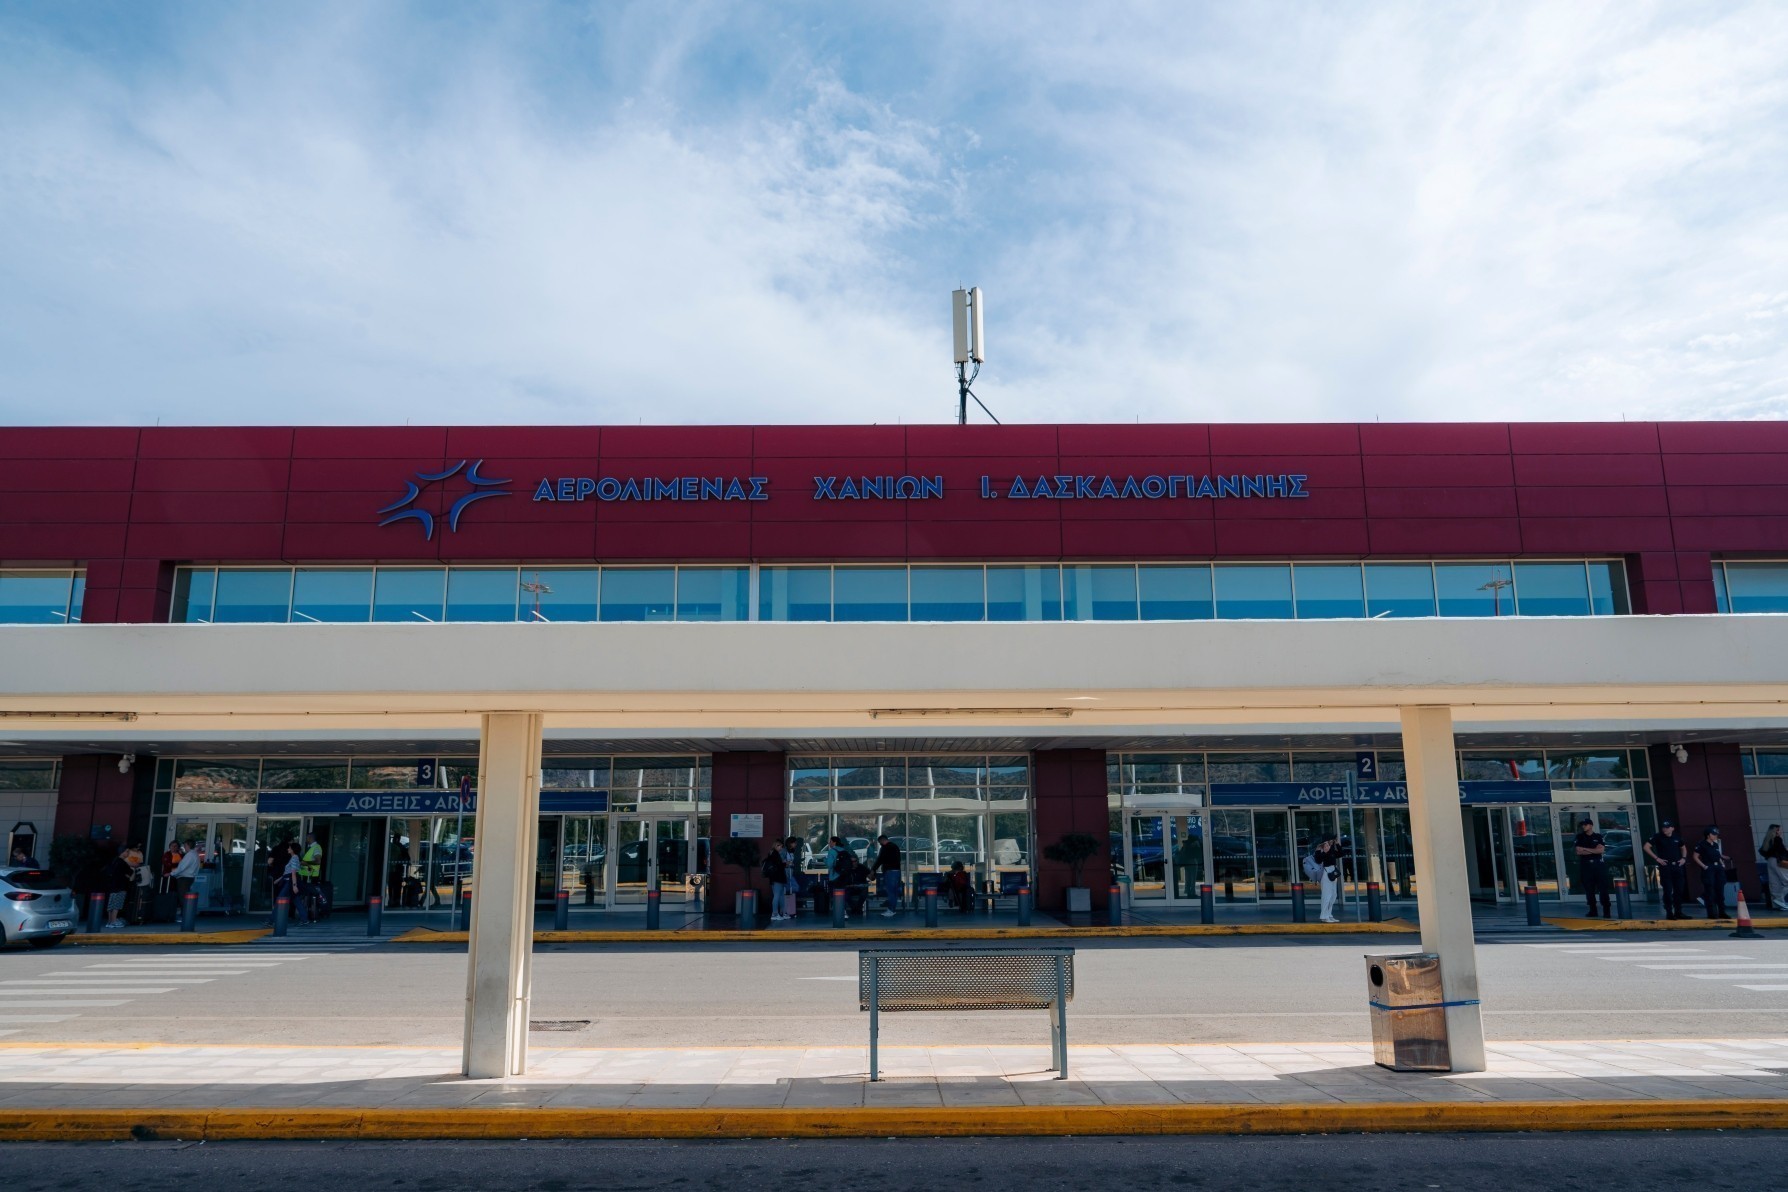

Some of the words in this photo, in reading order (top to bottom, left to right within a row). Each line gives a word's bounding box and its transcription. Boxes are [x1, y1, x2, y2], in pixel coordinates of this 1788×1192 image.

[533, 477, 769, 501] ΑΕΡΟΛΙΜΕΝΑΣ
[813, 475, 943, 500] ΧΑΝΙΩΝ
[1007, 474, 1310, 499] ΔΑΣΚΑΛΟΓΙΑΝΝΗΣ
[1361, 757, 1372, 772] 2
[422, 765, 432, 779] 3
[346, 796, 421, 810] ΑΦΙΞΕΙΣ
